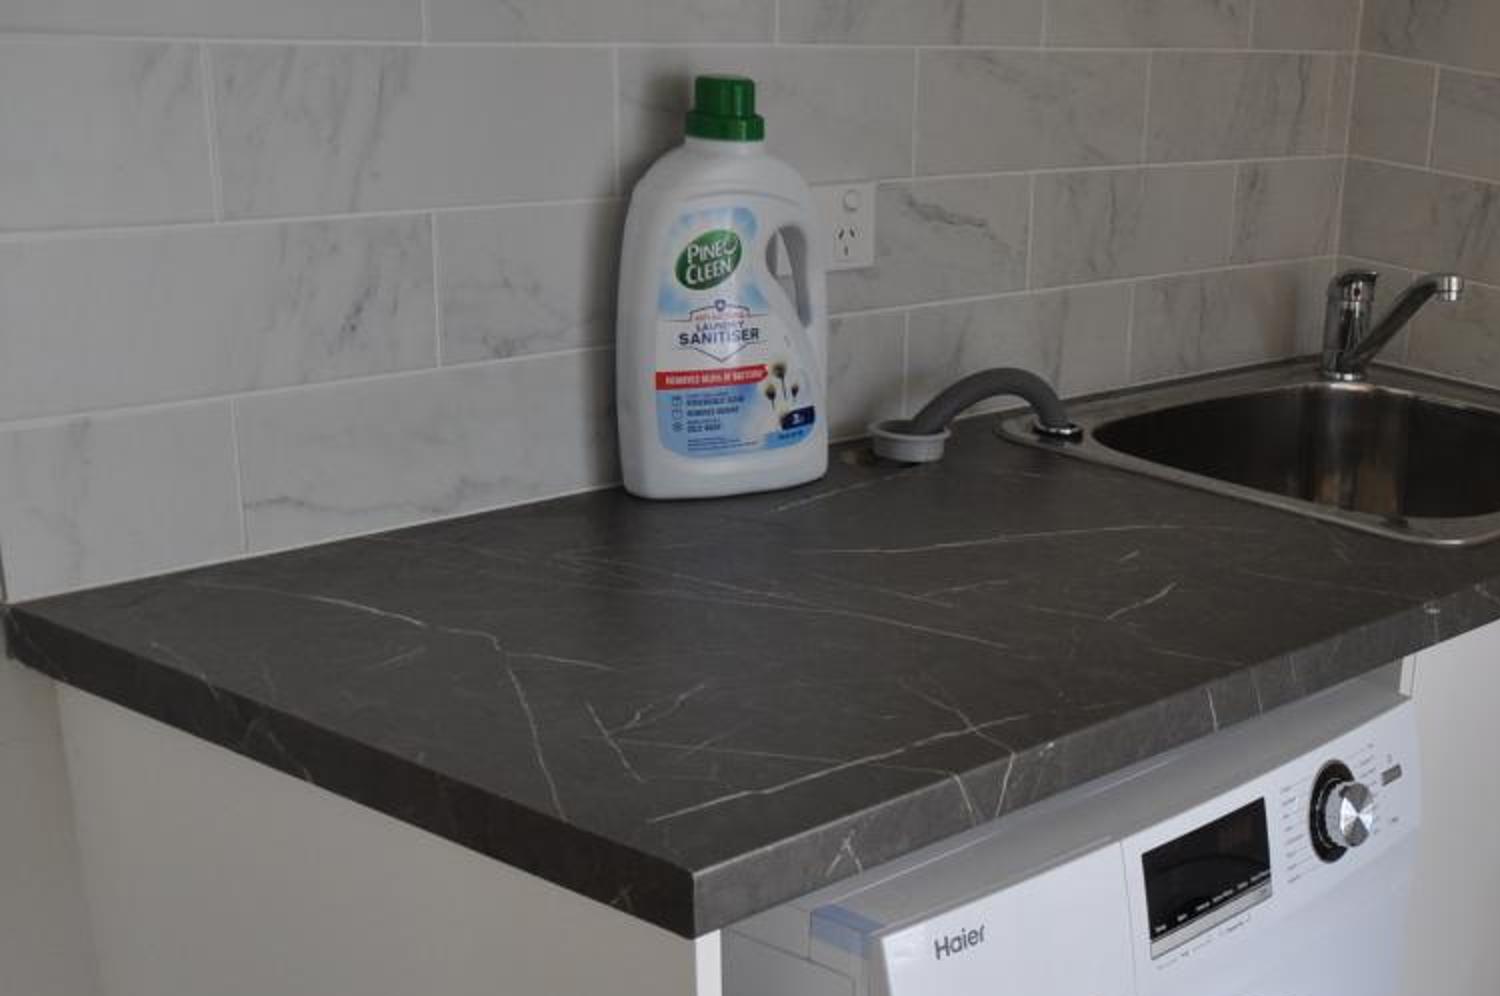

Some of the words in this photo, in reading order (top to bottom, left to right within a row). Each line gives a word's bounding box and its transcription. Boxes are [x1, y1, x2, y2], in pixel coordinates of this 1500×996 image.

[685, 257, 732, 285] CLEEN
[678, 327, 760, 346] SANITISER
[934, 924, 986, 961] Haier
